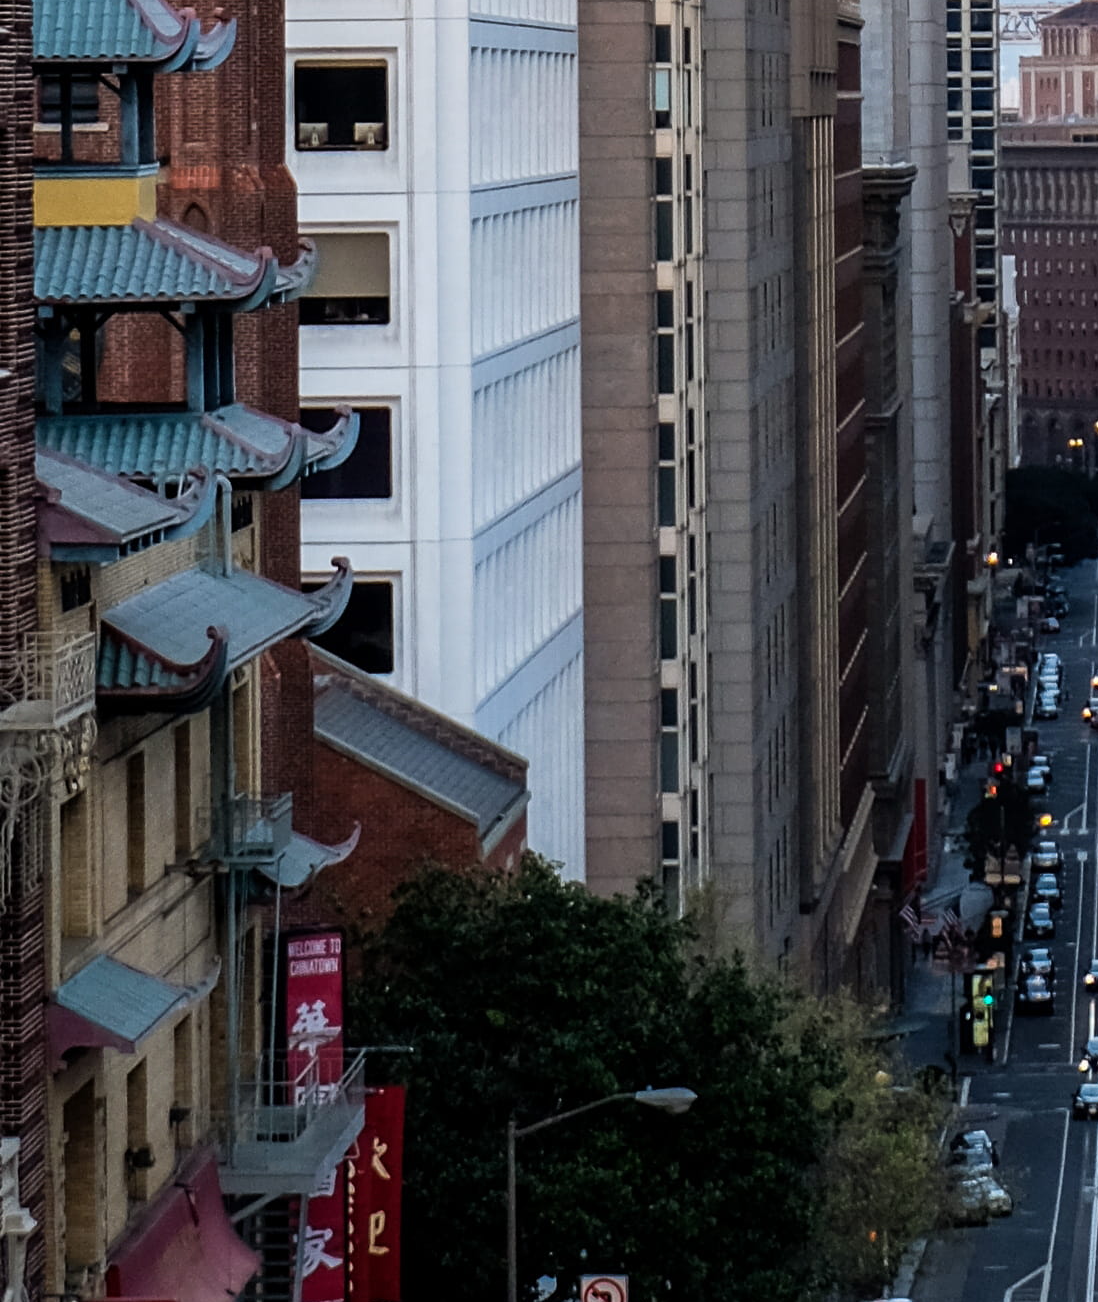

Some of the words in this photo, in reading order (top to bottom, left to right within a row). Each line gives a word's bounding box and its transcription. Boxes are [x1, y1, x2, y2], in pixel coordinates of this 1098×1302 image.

[288, 939, 327, 957] WELCOME
[330, 938, 341, 954] TO
[290, 958, 339, 976] CHINATOWN
